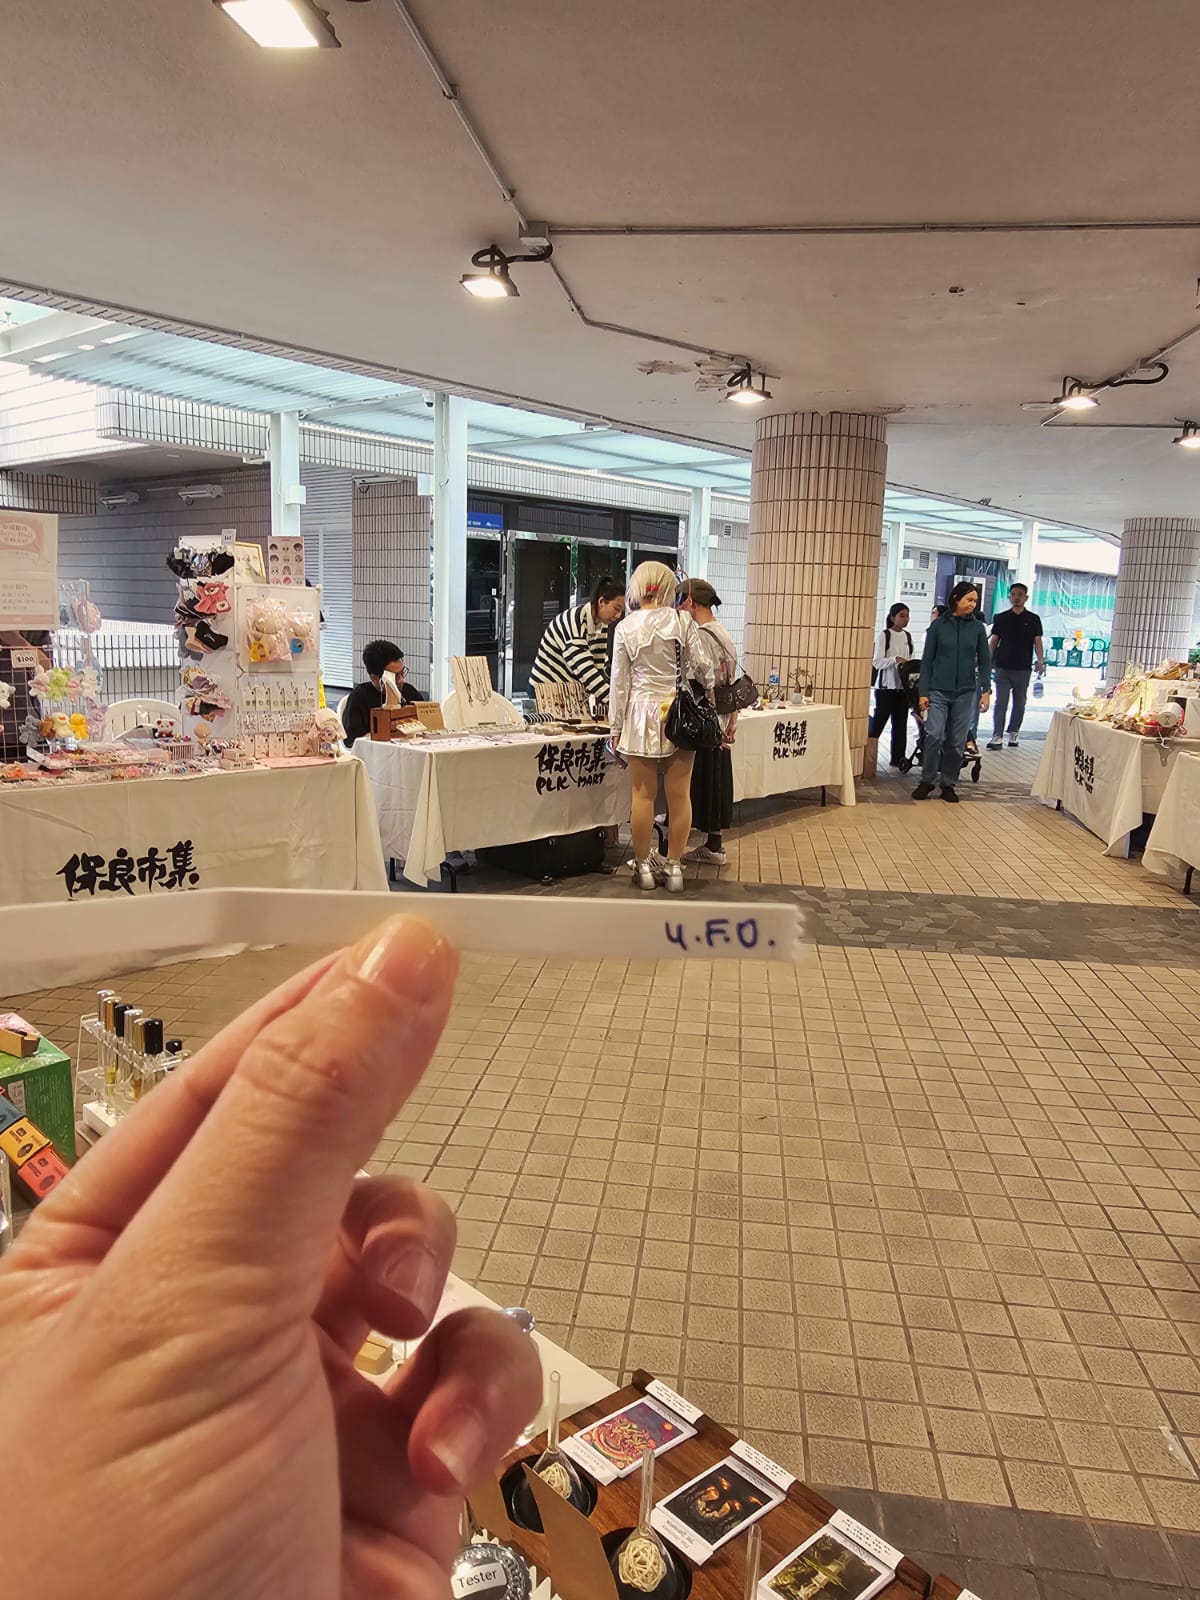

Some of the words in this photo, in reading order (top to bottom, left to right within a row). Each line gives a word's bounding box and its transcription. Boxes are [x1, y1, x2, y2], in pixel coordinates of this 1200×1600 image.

[773, 720, 807, 747] 保良市集
[534, 738, 606, 779] 保良市集
[773, 746, 790, 761] PLK
[536, 776, 570, 796] PLK
[577, 773, 606, 788] MART
[56, 840, 200, 898] 保良市集
[457, 1569, 497, 1589] Tester
